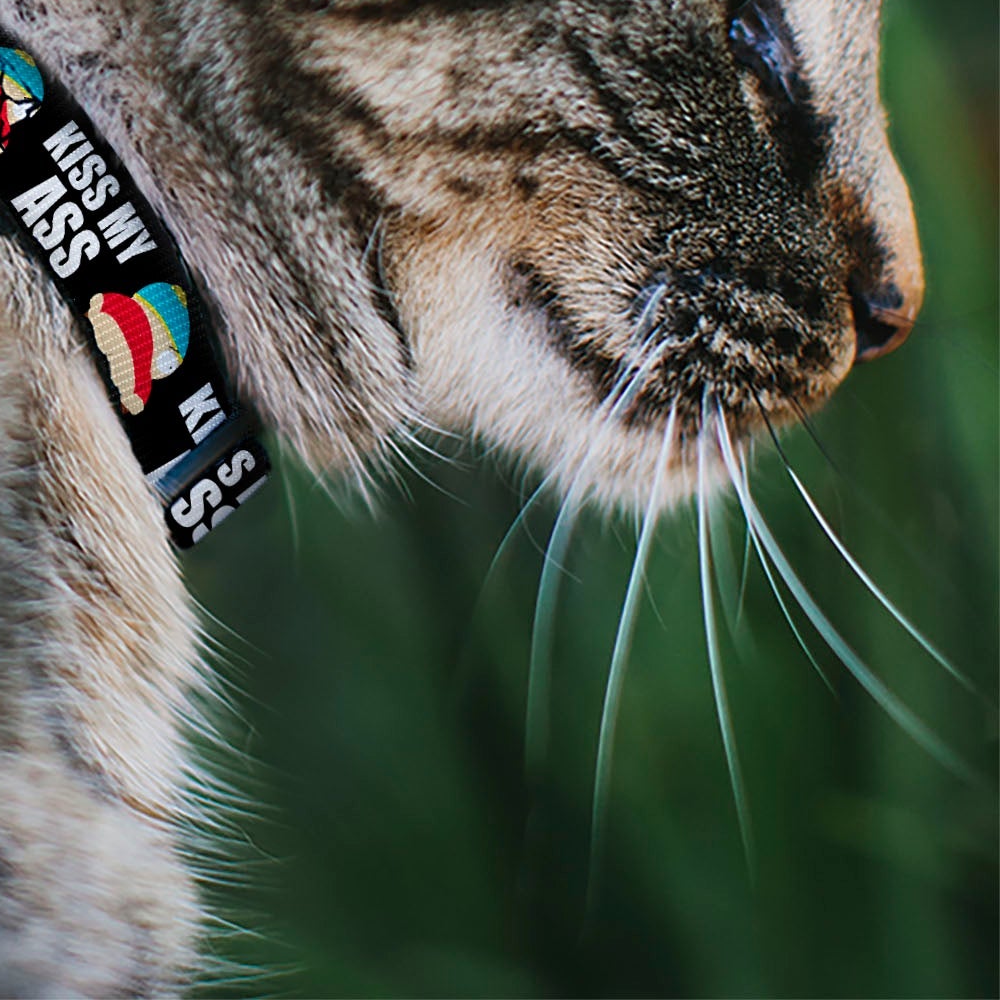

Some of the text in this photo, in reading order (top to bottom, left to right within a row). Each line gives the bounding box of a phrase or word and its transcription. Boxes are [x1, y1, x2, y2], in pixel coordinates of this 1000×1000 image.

[10, 174, 100, 279] ASS
[42, 120, 158, 264] KISS MY
